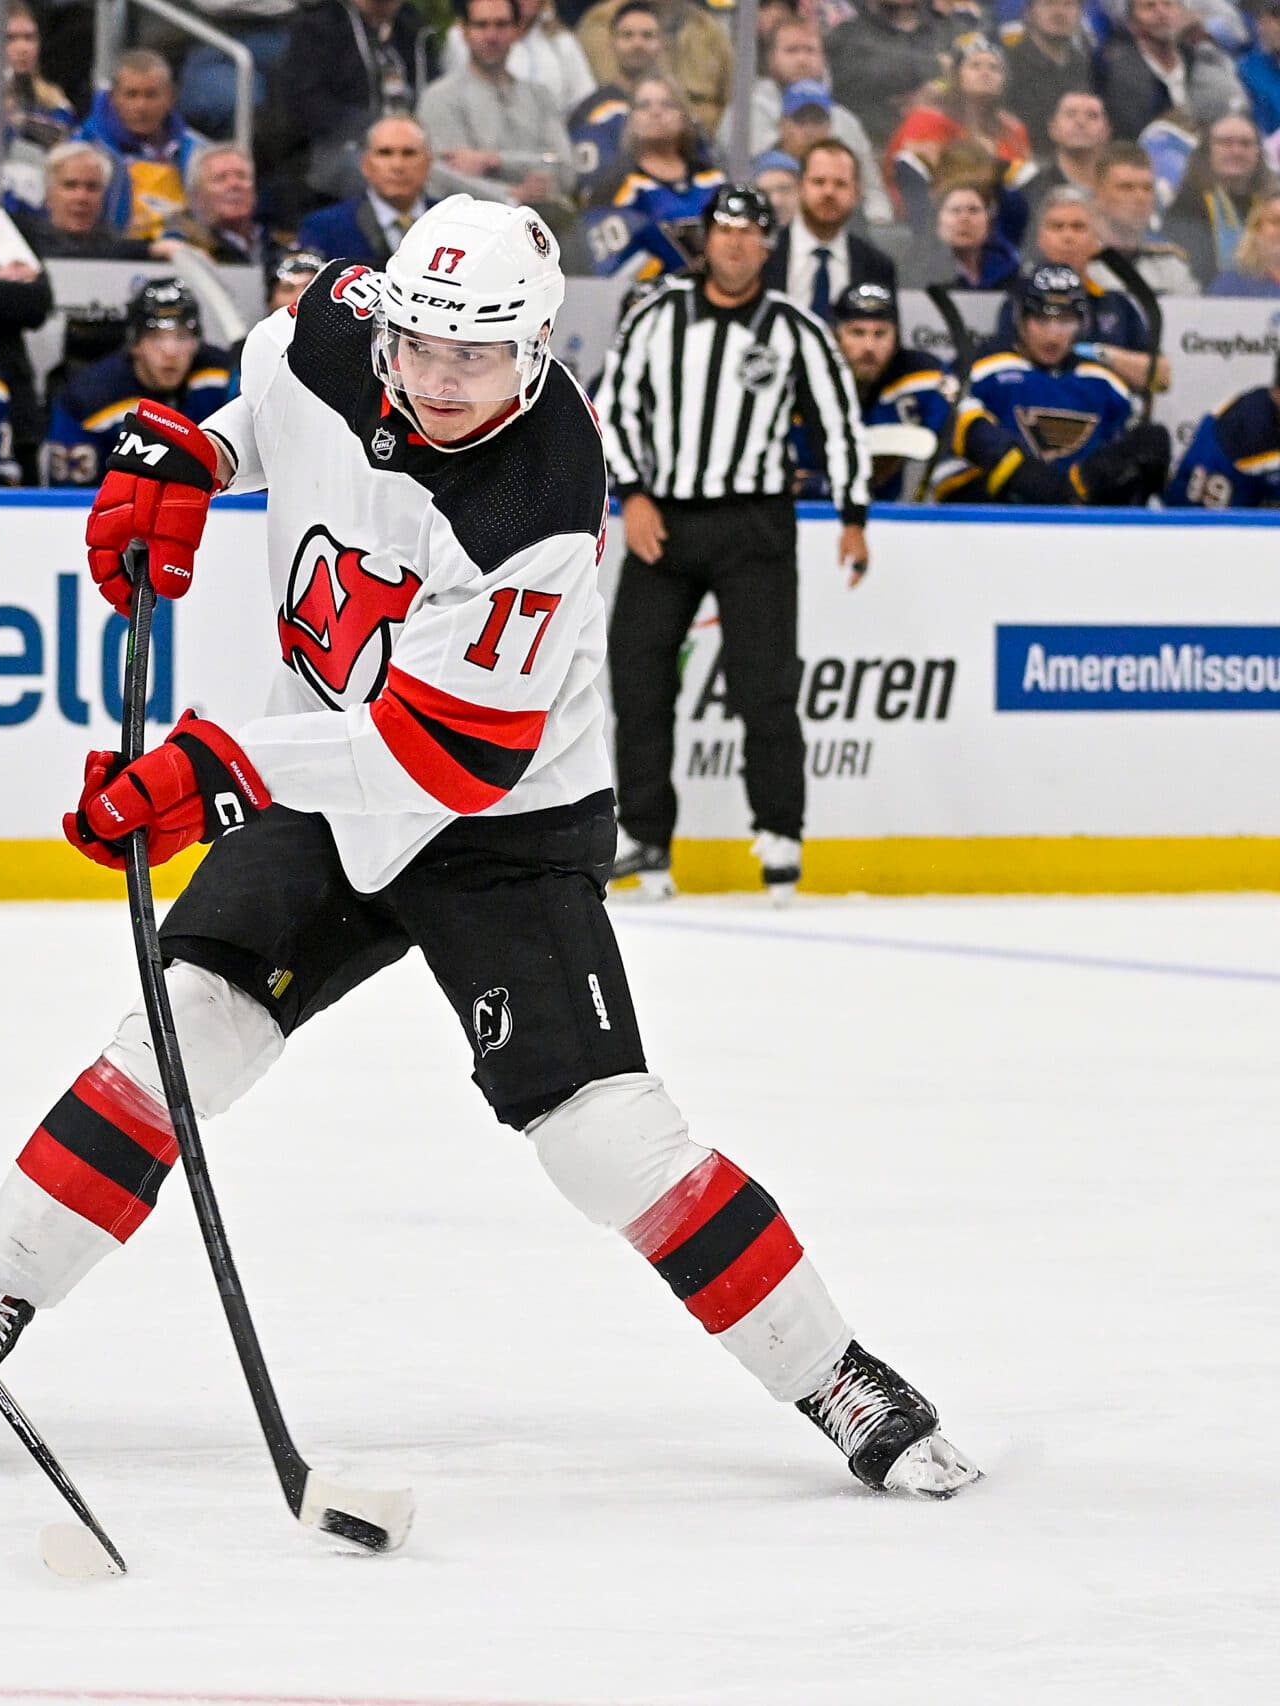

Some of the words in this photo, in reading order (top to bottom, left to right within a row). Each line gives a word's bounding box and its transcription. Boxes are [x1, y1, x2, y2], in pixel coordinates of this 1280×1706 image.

[428, 246, 466, 274] 17
[410, 292, 467, 312] CCM
[162, 563, 191, 580] CCM
[463, 587, 562, 675] 17
[691, 655, 956, 722] Aeren
[1022, 643, 1280, 693] AmerenMissou
[687, 739, 873, 780] MIURI
[99, 793, 125, 823] CCM
[587, 973, 612, 1031] CCM
